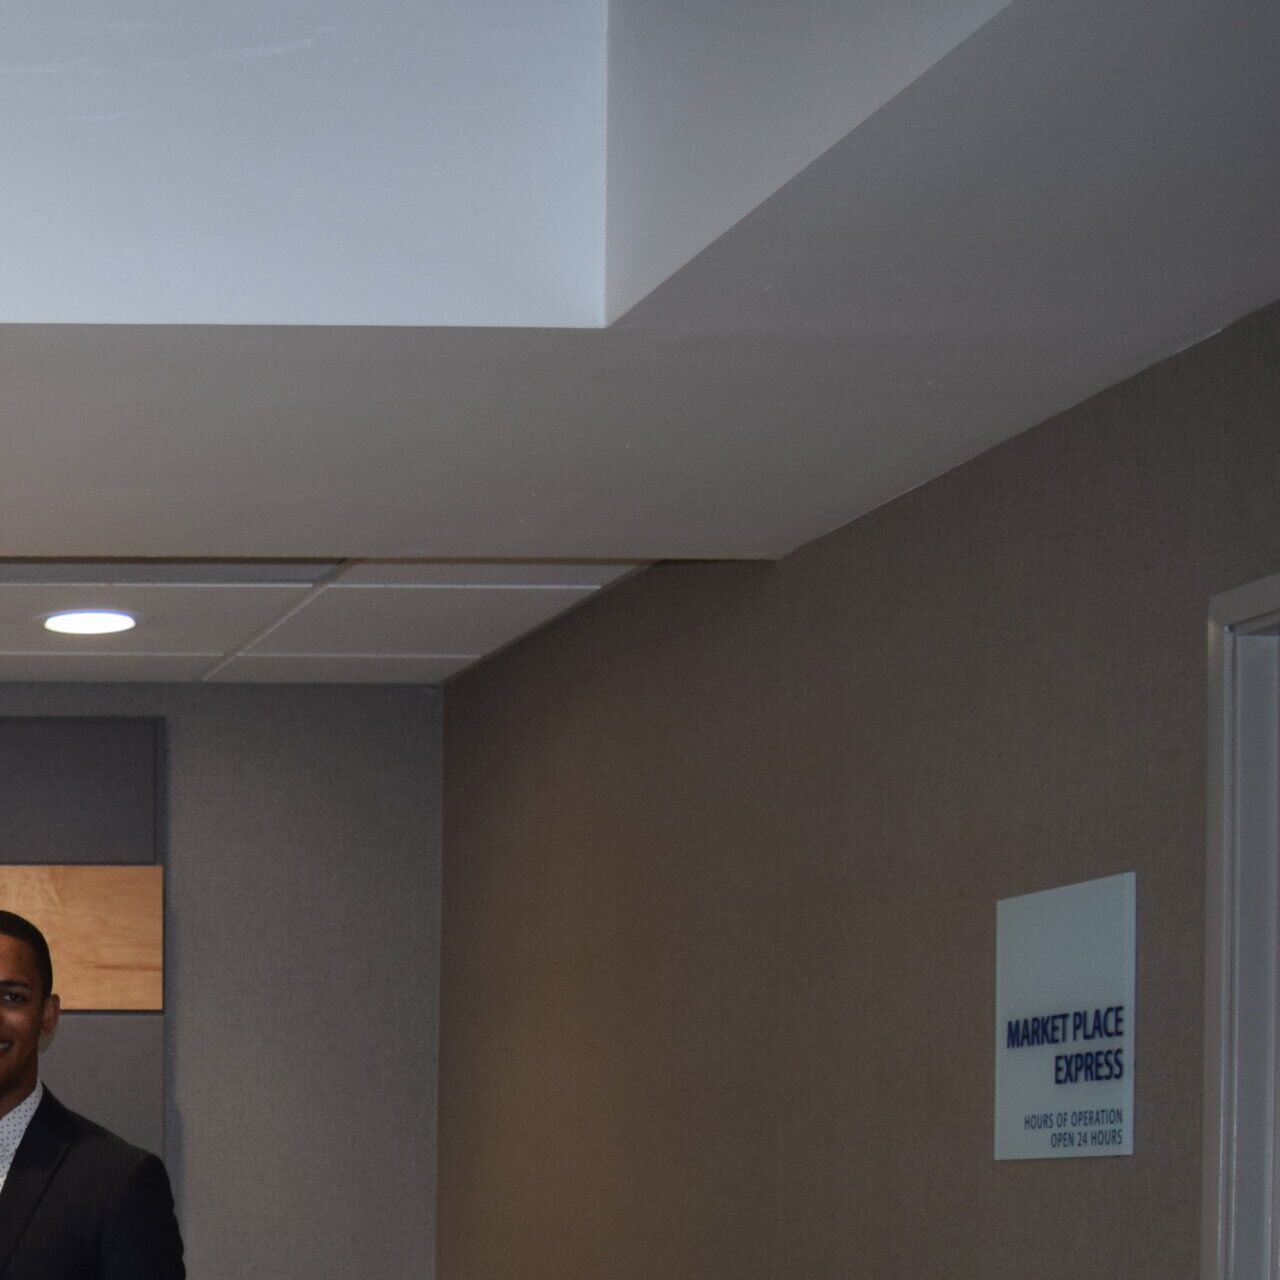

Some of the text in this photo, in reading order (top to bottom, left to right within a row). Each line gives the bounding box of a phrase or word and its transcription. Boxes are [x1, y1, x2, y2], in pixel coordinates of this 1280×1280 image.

[1007, 1006, 1124, 1049] MARKET PLACE
[1054, 1048, 1124, 1085] EXPRESS
[1024, 1109, 1123, 1130] HOURS OF OPERATION
[1050, 1129, 1123, 1148] OPEN 24 HOURS
